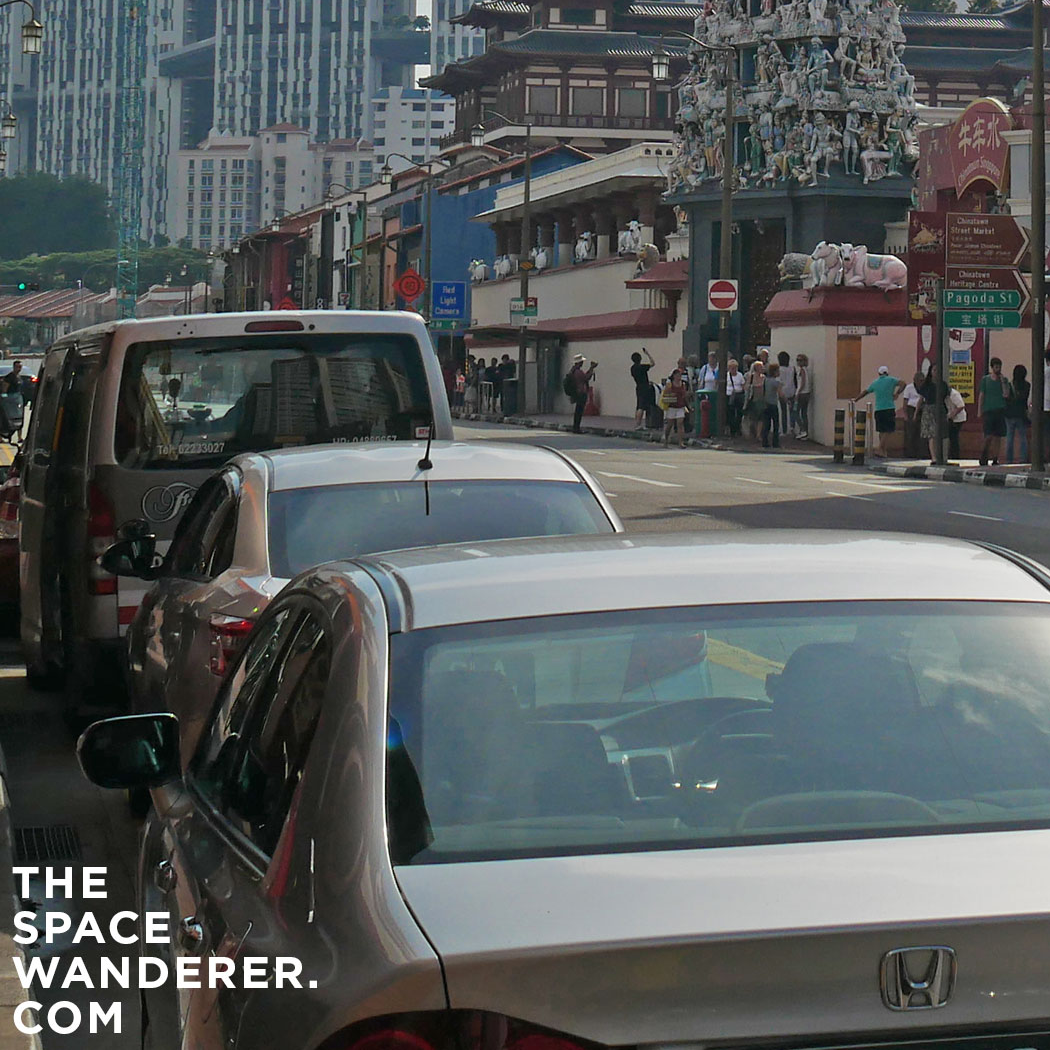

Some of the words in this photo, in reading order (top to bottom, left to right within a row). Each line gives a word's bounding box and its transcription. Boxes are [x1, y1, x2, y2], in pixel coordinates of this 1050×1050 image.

[957, 217, 989, 225] Chinatown
[950, 280, 976, 289] Heritage
[442, 285, 456, 294] Red
[440, 296, 457, 306] Light
[947, 292, 995, 305] Pagoda
[1000, 292, 1012, 303] St
[435, 307, 460, 315] Camera
